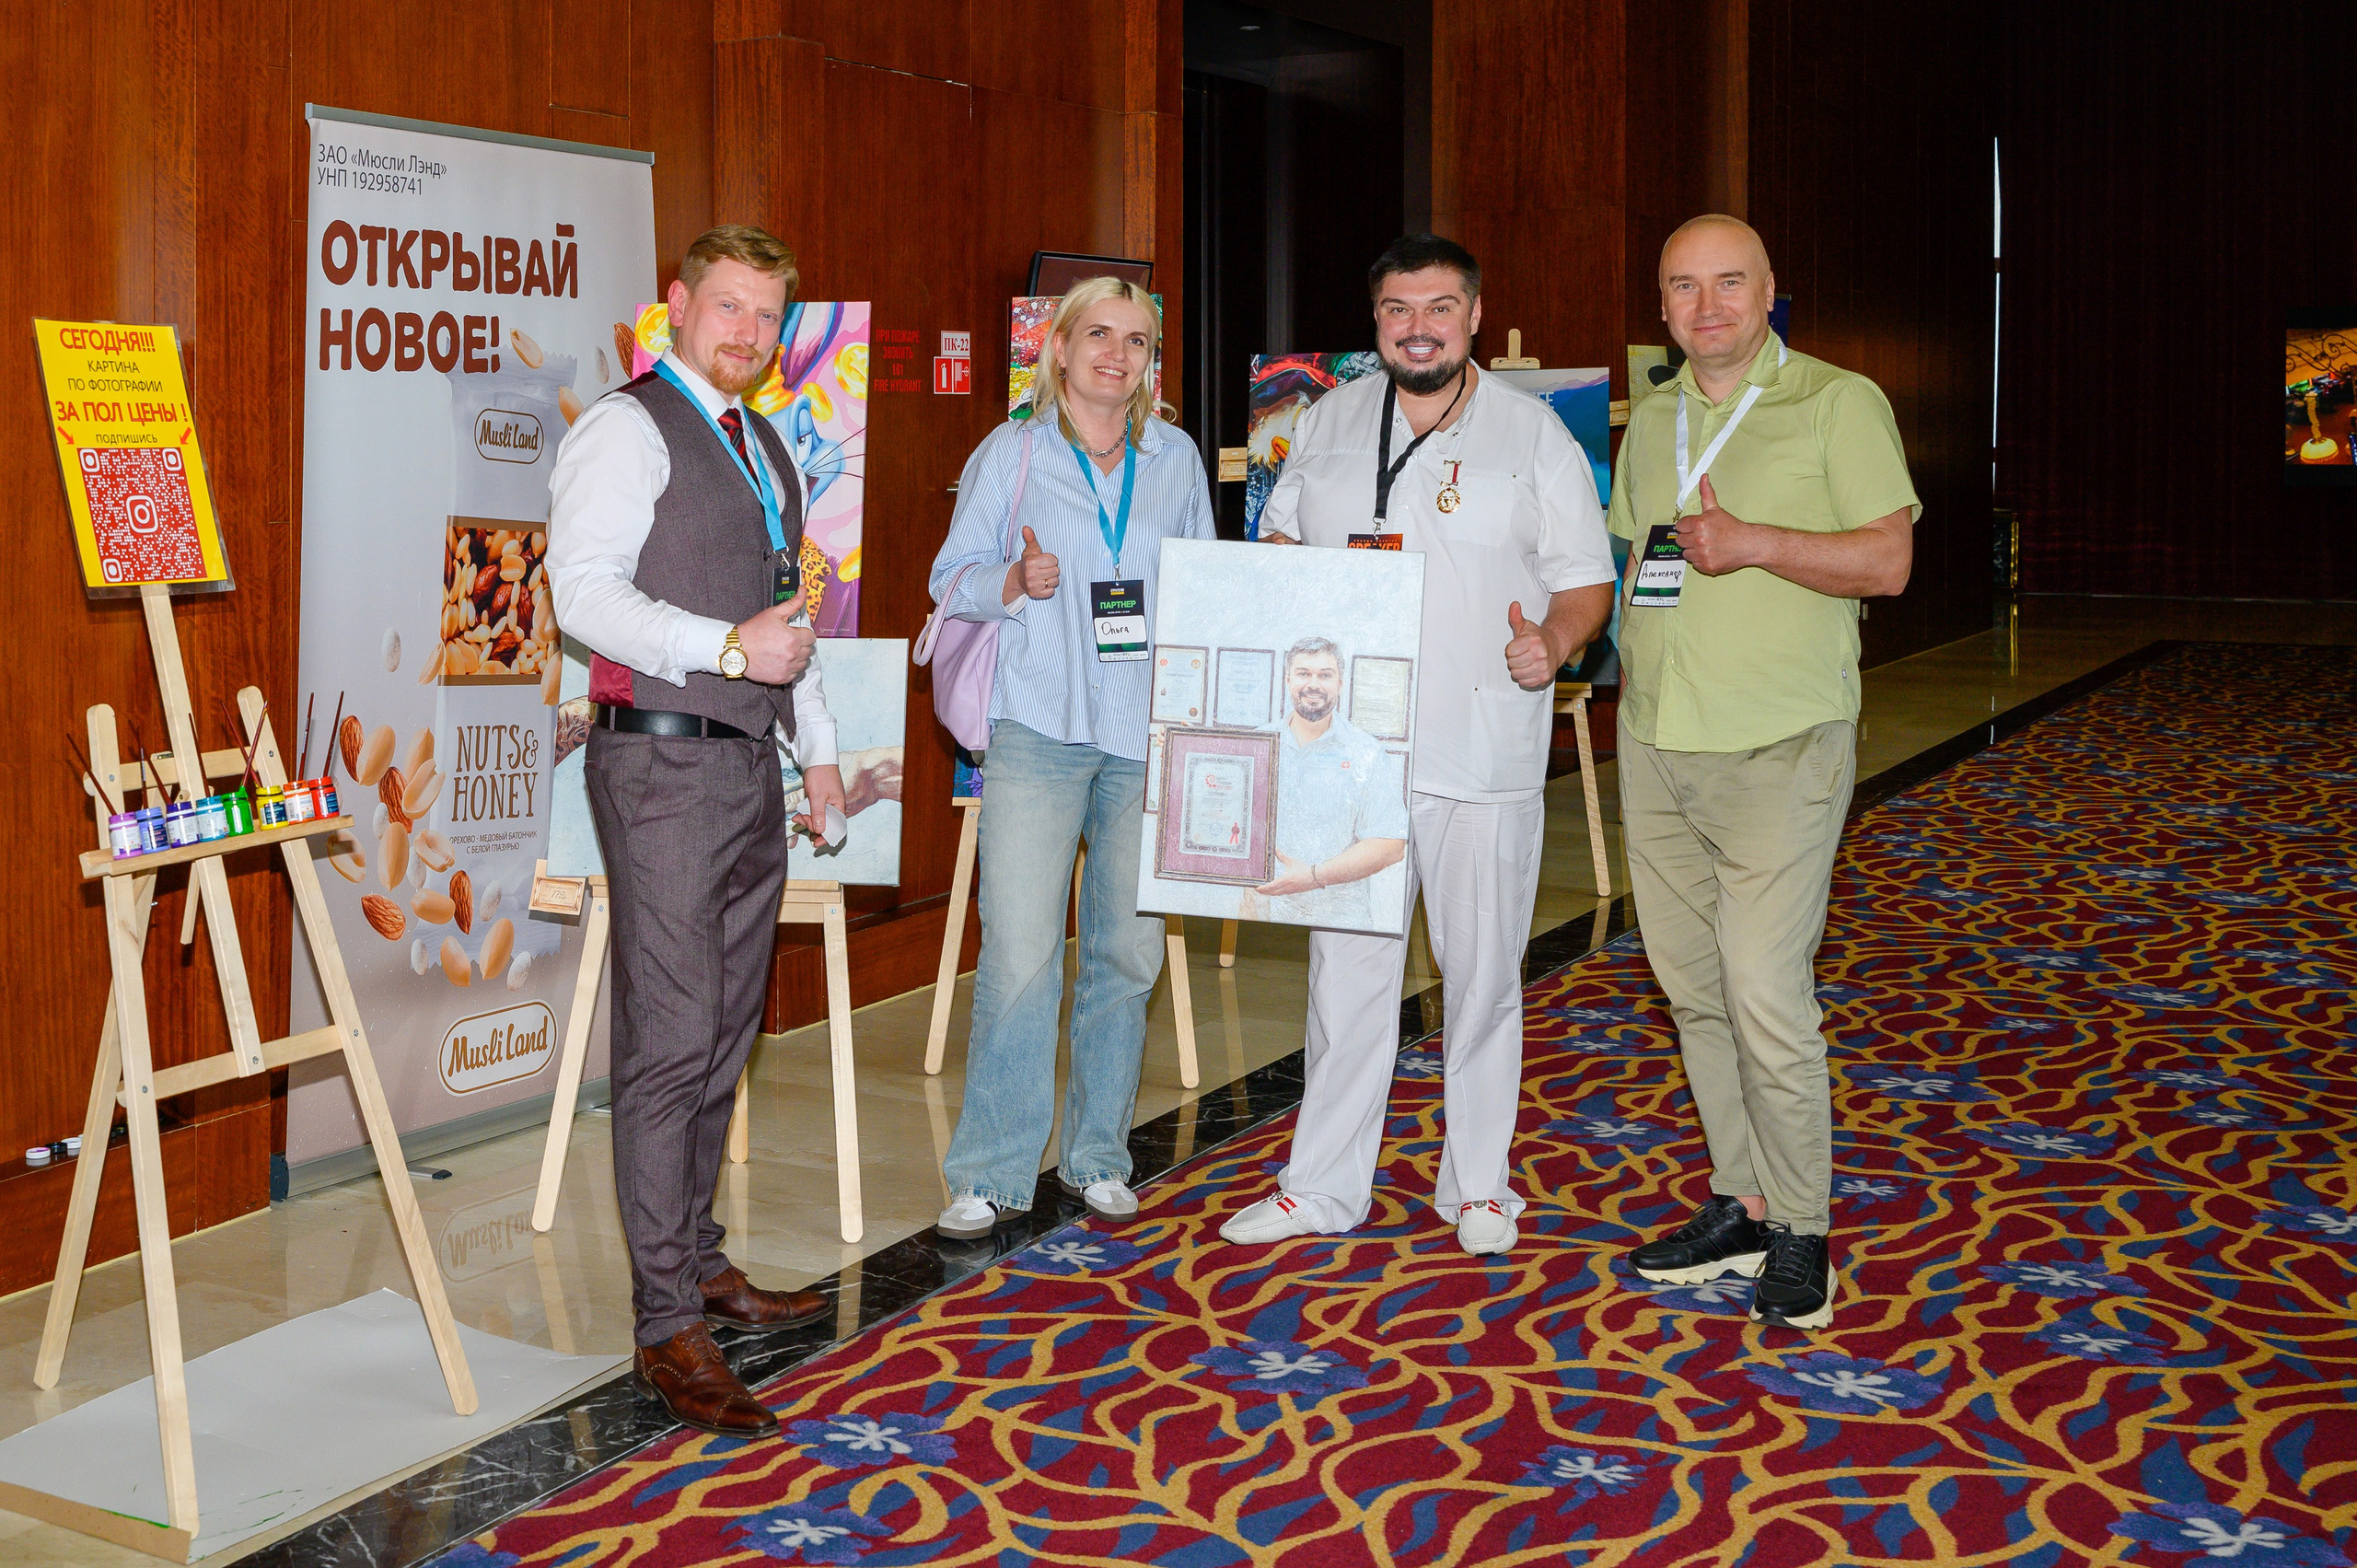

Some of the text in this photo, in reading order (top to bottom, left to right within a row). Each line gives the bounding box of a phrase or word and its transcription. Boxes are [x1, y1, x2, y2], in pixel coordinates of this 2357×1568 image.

[318, 144, 447, 180] ЗАО «Мюсли Лэнд»
[318, 167, 422, 195] УНП 192958741
[321, 219, 578, 299] ОТКРЫВАЙ
[60, 327, 157, 355] СЕГОДНЯ!!!
[319, 308, 501, 374] НОВОЕ!
[876, 329, 920, 343] ПРИ ПОЖАРЕ
[883, 345, 913, 359] ЗВОНИТЬ
[944, 337, 970, 352] ПК-22
[87, 359, 140, 374] КАРТИНА
[892, 363, 904, 376] 101
[68, 377, 164, 393] ПО ФОТОГРАФИИ
[874, 378, 921, 392] FIRE HYDRANT
[55, 400, 80, 423] ЗА
[84, 401, 124, 423] ПОЛ
[127, 402, 177, 426] ЦЕНЫ
[95, 433, 158, 446] ПОДПИШИСЬ
[1654, 545, 1682, 553] ПАРТН
[1099, 599, 1137, 610] ПАРТНЕР
[456, 724, 539, 772] NUTS&
[451, 772, 539, 822] HONEY
[449, 835, 476, 844] ОРЕХОВО
[480, 832, 507, 846] МЕДОВЫЙ
[508, 830, 538, 841] БАТОНЧИК
[471, 843, 491, 854] БЕЛОЙ
[491, 842, 520, 853] ГЛАЗУРЬЮ
